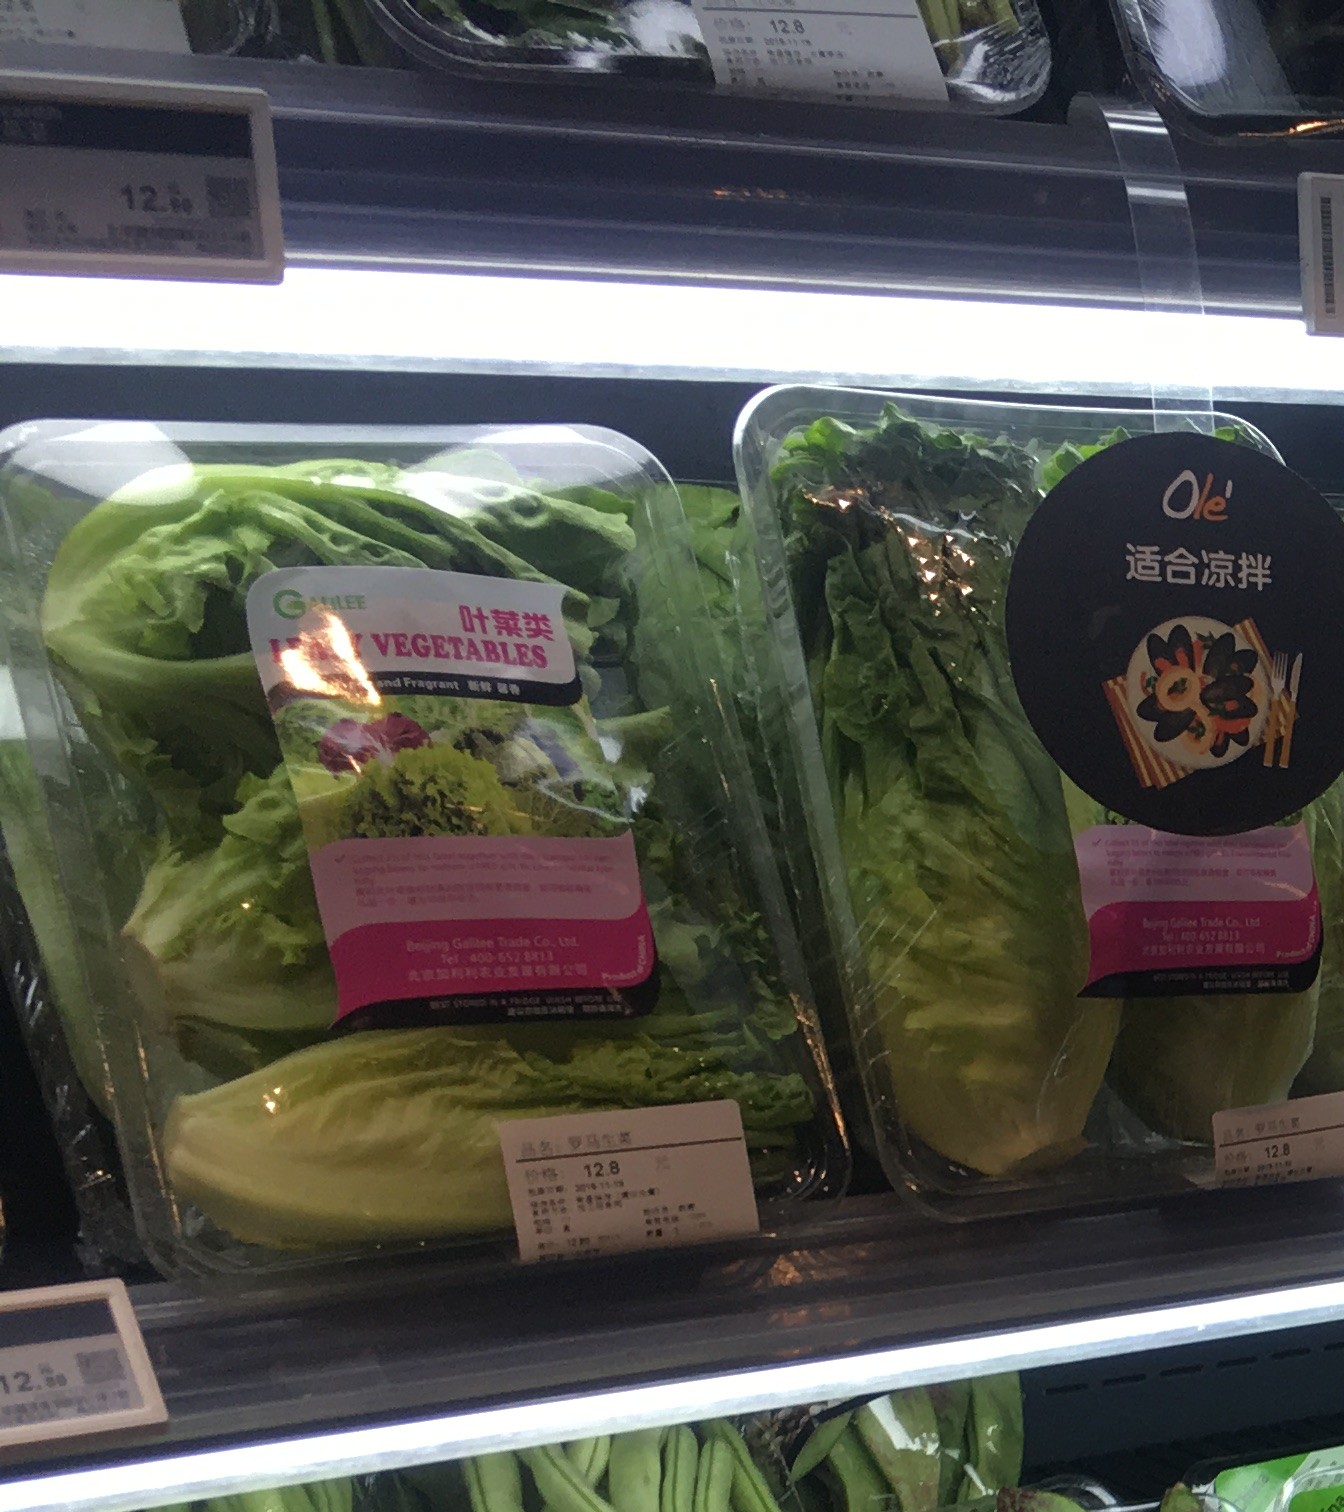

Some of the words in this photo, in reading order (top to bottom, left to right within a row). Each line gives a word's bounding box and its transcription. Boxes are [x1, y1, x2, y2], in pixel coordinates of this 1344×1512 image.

[770, 19, 805, 34] 12.8
[1125, 542, 1272, 591] 适合凉拌
[458, 604, 554, 642] 叶菜类
[371, 632, 549, 669] VEGETABLES
[404, 676, 459, 692] Fragrant
[1264, 1144, 1291, 1159] 12.8
[584, 1160, 620, 1178] 12.8
